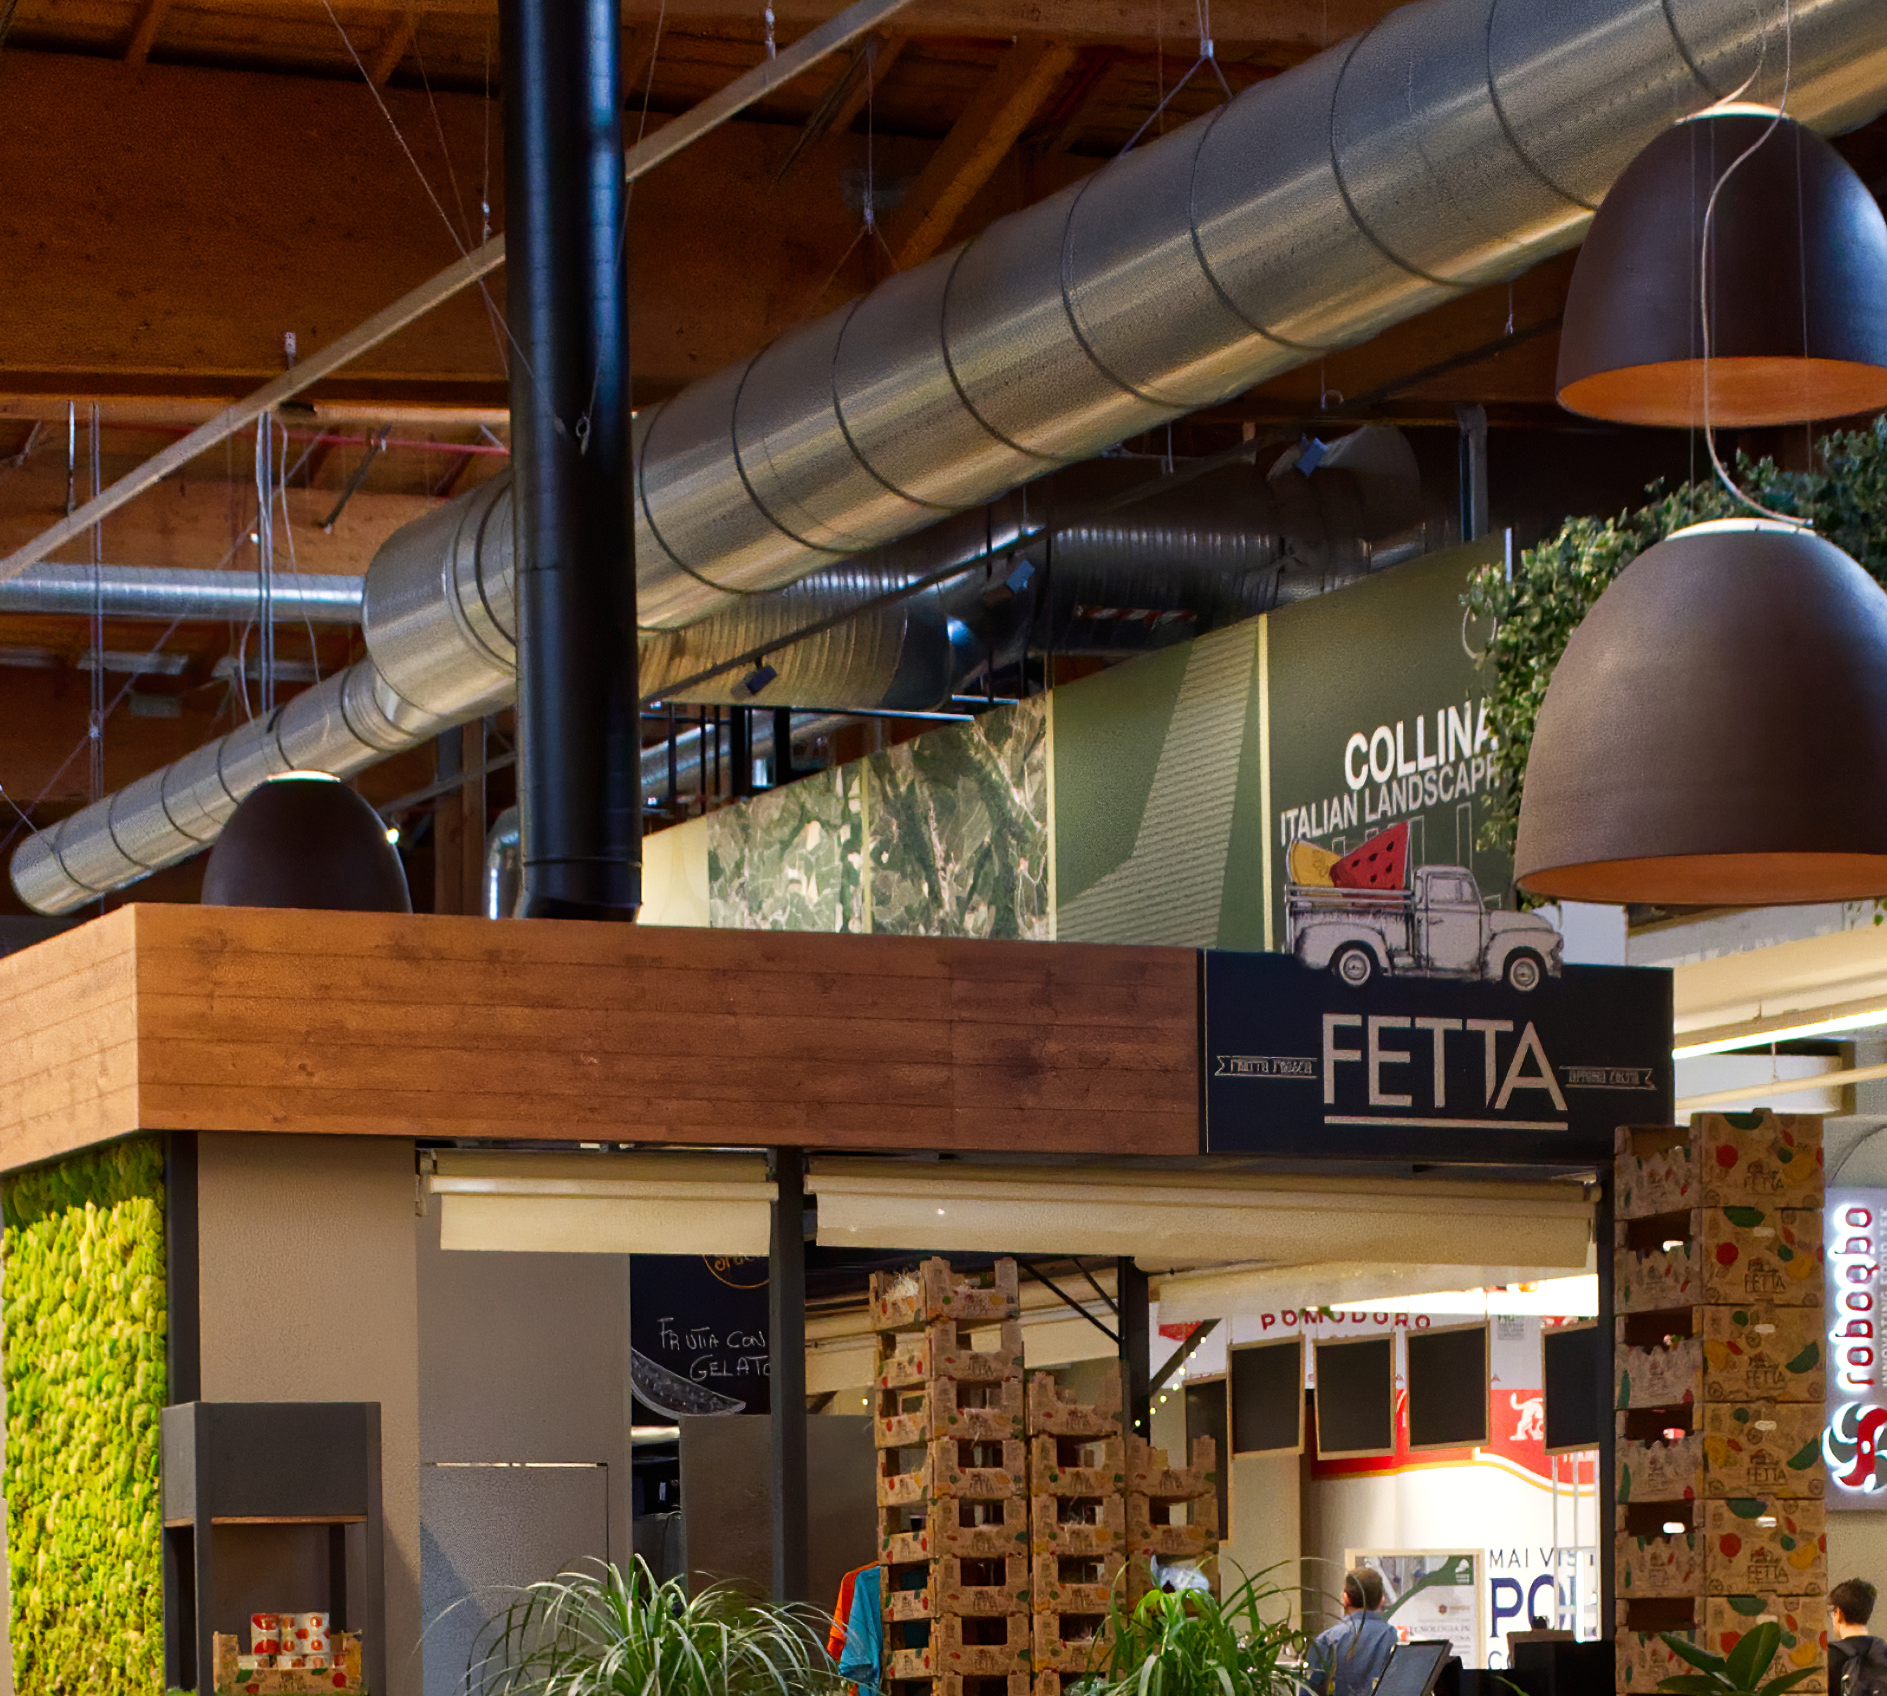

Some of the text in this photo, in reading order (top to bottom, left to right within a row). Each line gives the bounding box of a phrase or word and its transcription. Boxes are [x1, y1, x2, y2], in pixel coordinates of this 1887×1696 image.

[1281, 790, 1358, 847] ITALIAN
[1322, 1013, 1568, 1111] FETTA
[1834, 1207, 1880, 1385] roboqbo
[1747, 1466, 1788, 1485] FETTA
[1489, 1547, 1529, 1568] MAI
[1747, 1565, 1789, 1584] FETTA
